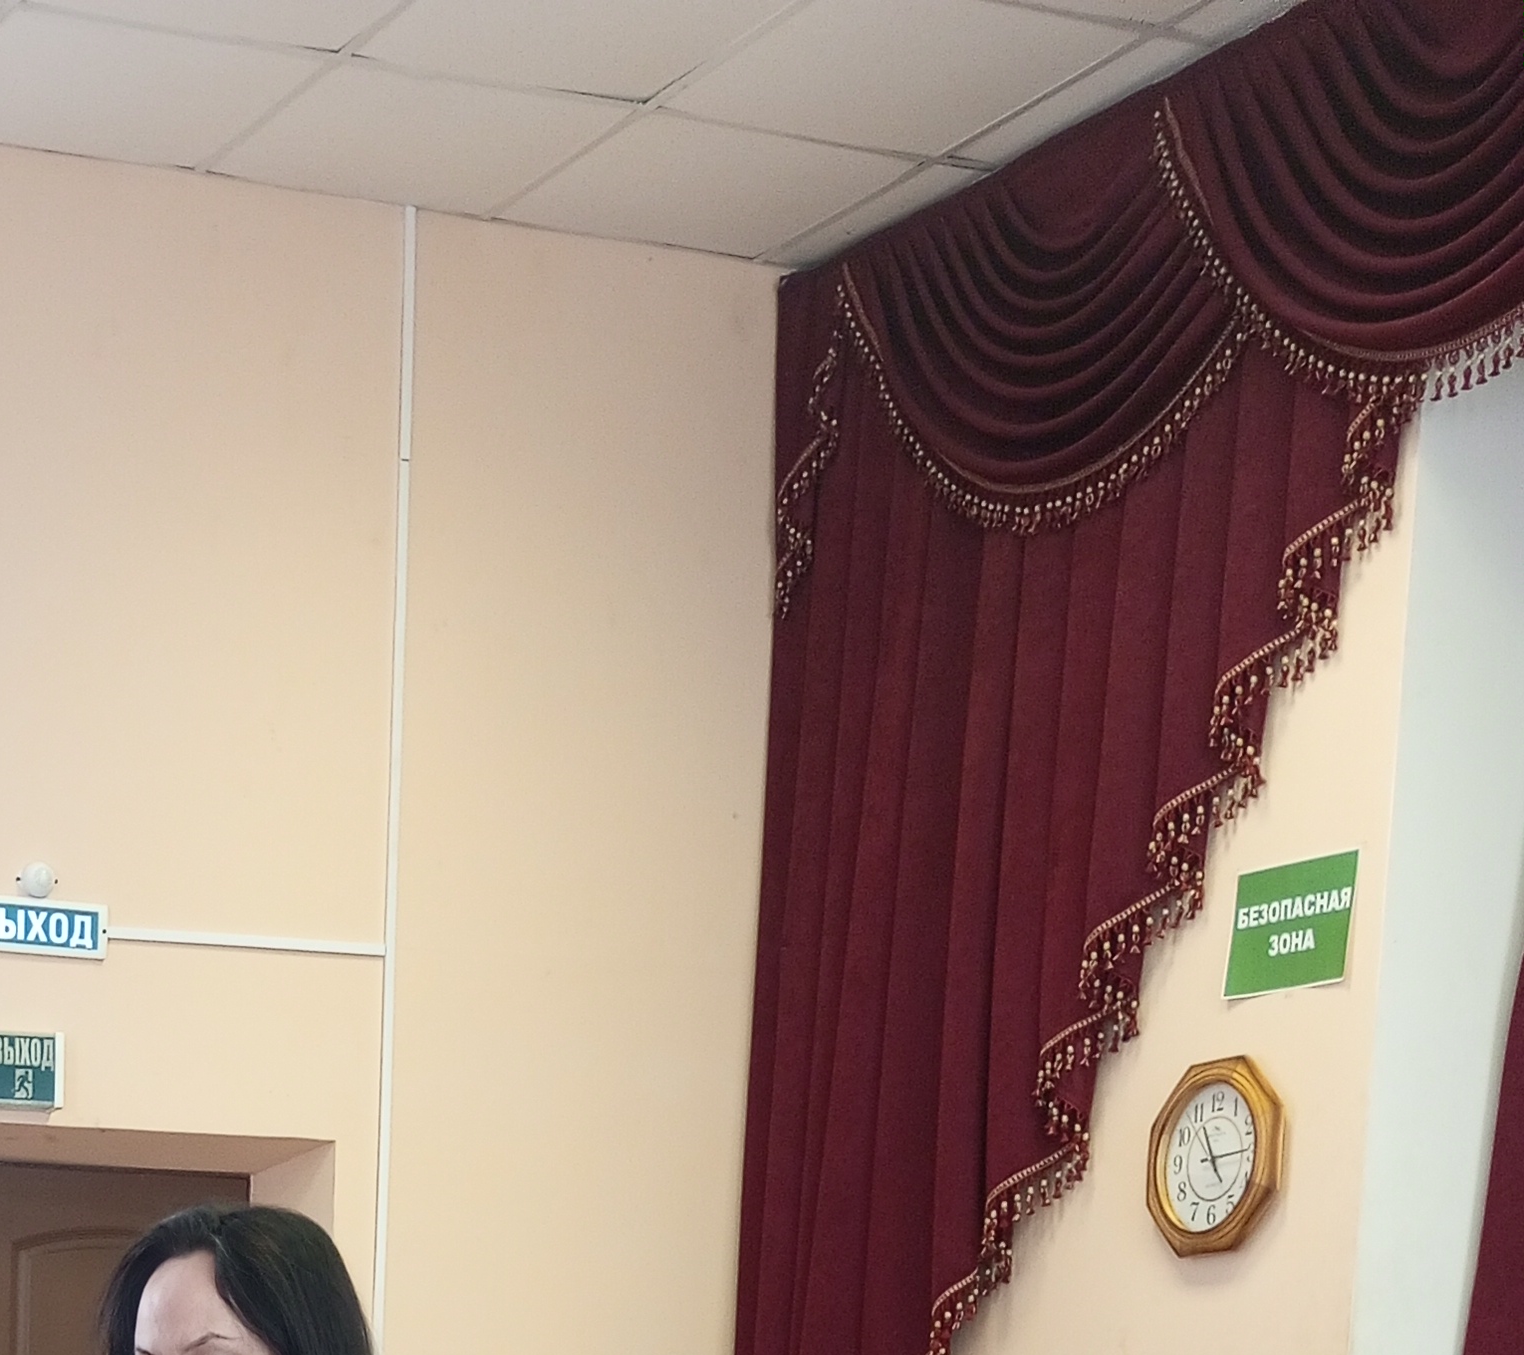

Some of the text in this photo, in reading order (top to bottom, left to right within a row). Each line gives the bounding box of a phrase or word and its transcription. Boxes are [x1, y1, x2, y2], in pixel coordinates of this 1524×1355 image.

[1236, 886, 1353, 931] БЕЗОПАСНАЯ
[1268, 929, 1315, 957] ЗОНА
[1211, 1091, 1225, 1113] 12
[1193, 1103, 1205, 1123] 11
[1178, 1127, 1191, 1147] 10
[1173, 1155, 1183, 1174] 9
[1177, 1182, 1187, 1202] 8
[1189, 1202, 1199, 1222] 7
[1206, 1204, 1216, 1225] 6
